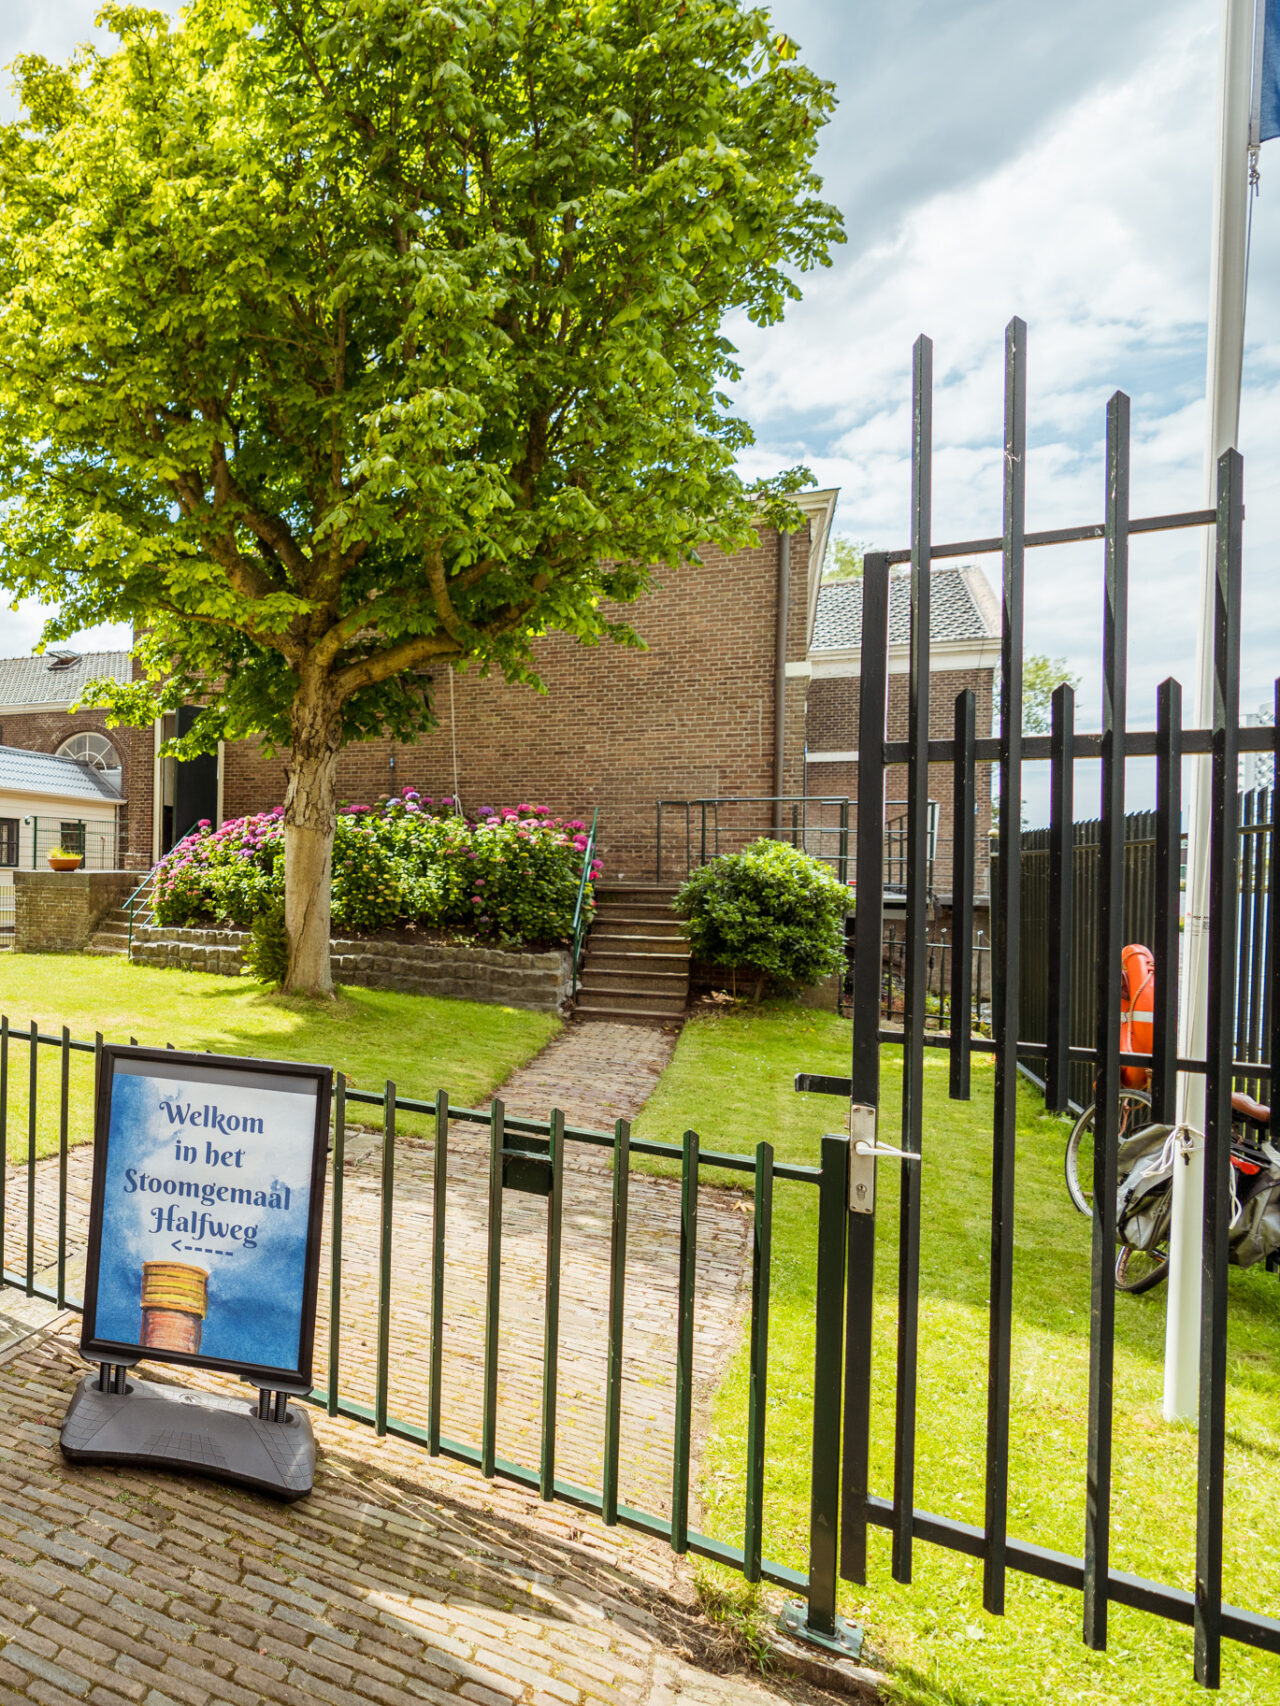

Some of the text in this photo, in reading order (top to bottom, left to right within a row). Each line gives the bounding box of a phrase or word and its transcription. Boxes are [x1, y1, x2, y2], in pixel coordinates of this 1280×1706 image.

[159, 1101, 265, 1136] Welkom
[174, 1139, 246, 1169] in het
[123, 1168, 291, 1211] Stoomgemaal
[148, 1204, 259, 1249] Halfweg
